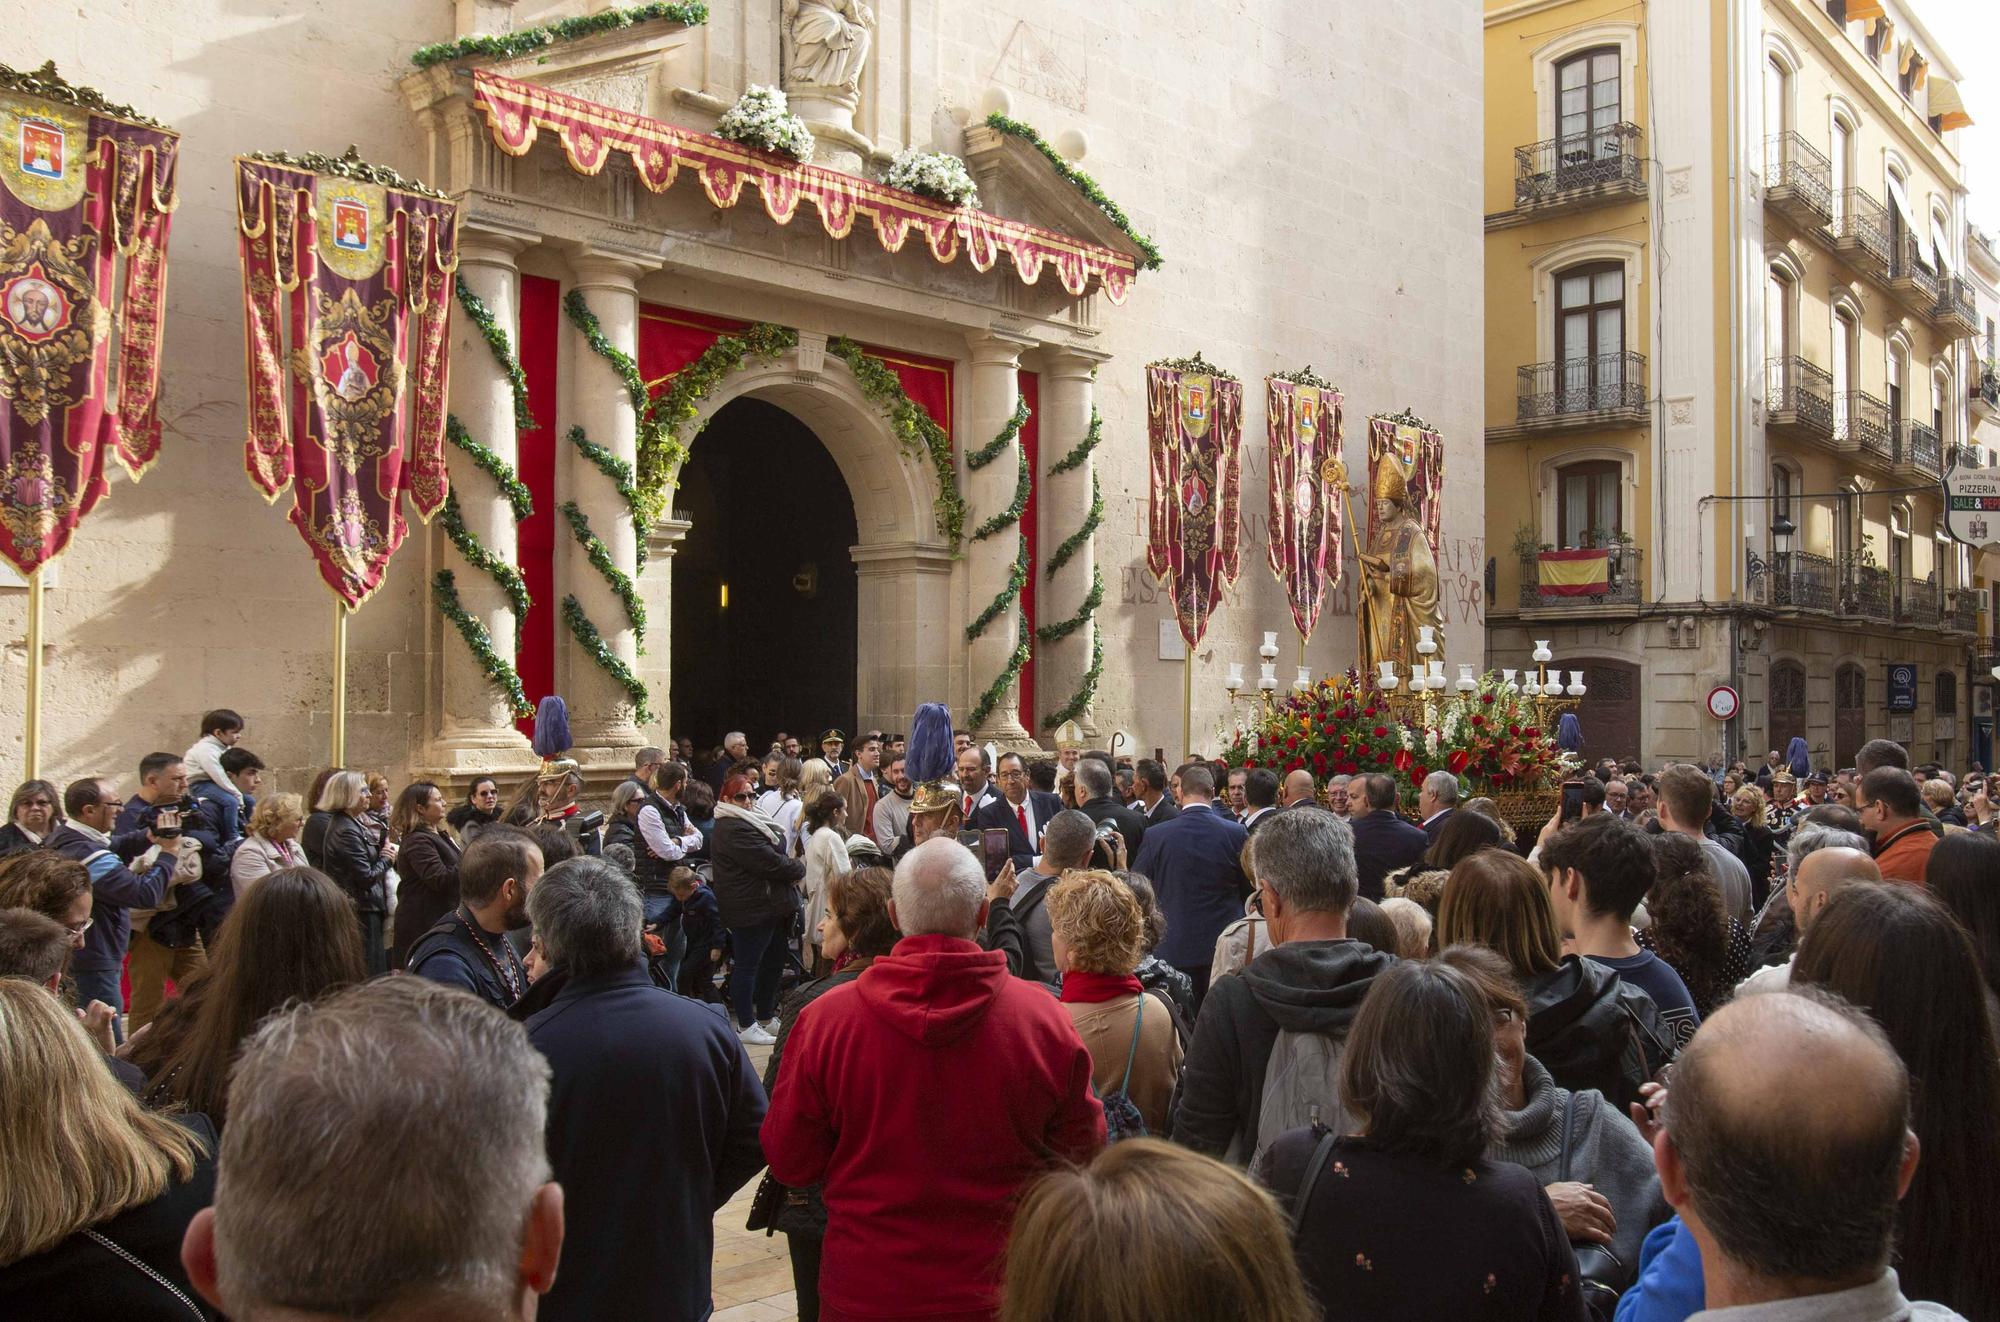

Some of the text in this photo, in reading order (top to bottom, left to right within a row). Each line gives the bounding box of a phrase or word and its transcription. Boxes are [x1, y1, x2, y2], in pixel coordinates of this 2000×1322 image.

[1960, 485, 1996, 494] PIZZERIA
[1954, 498, 1974, 509] SALE
[1974, 498, 1982, 509] &
